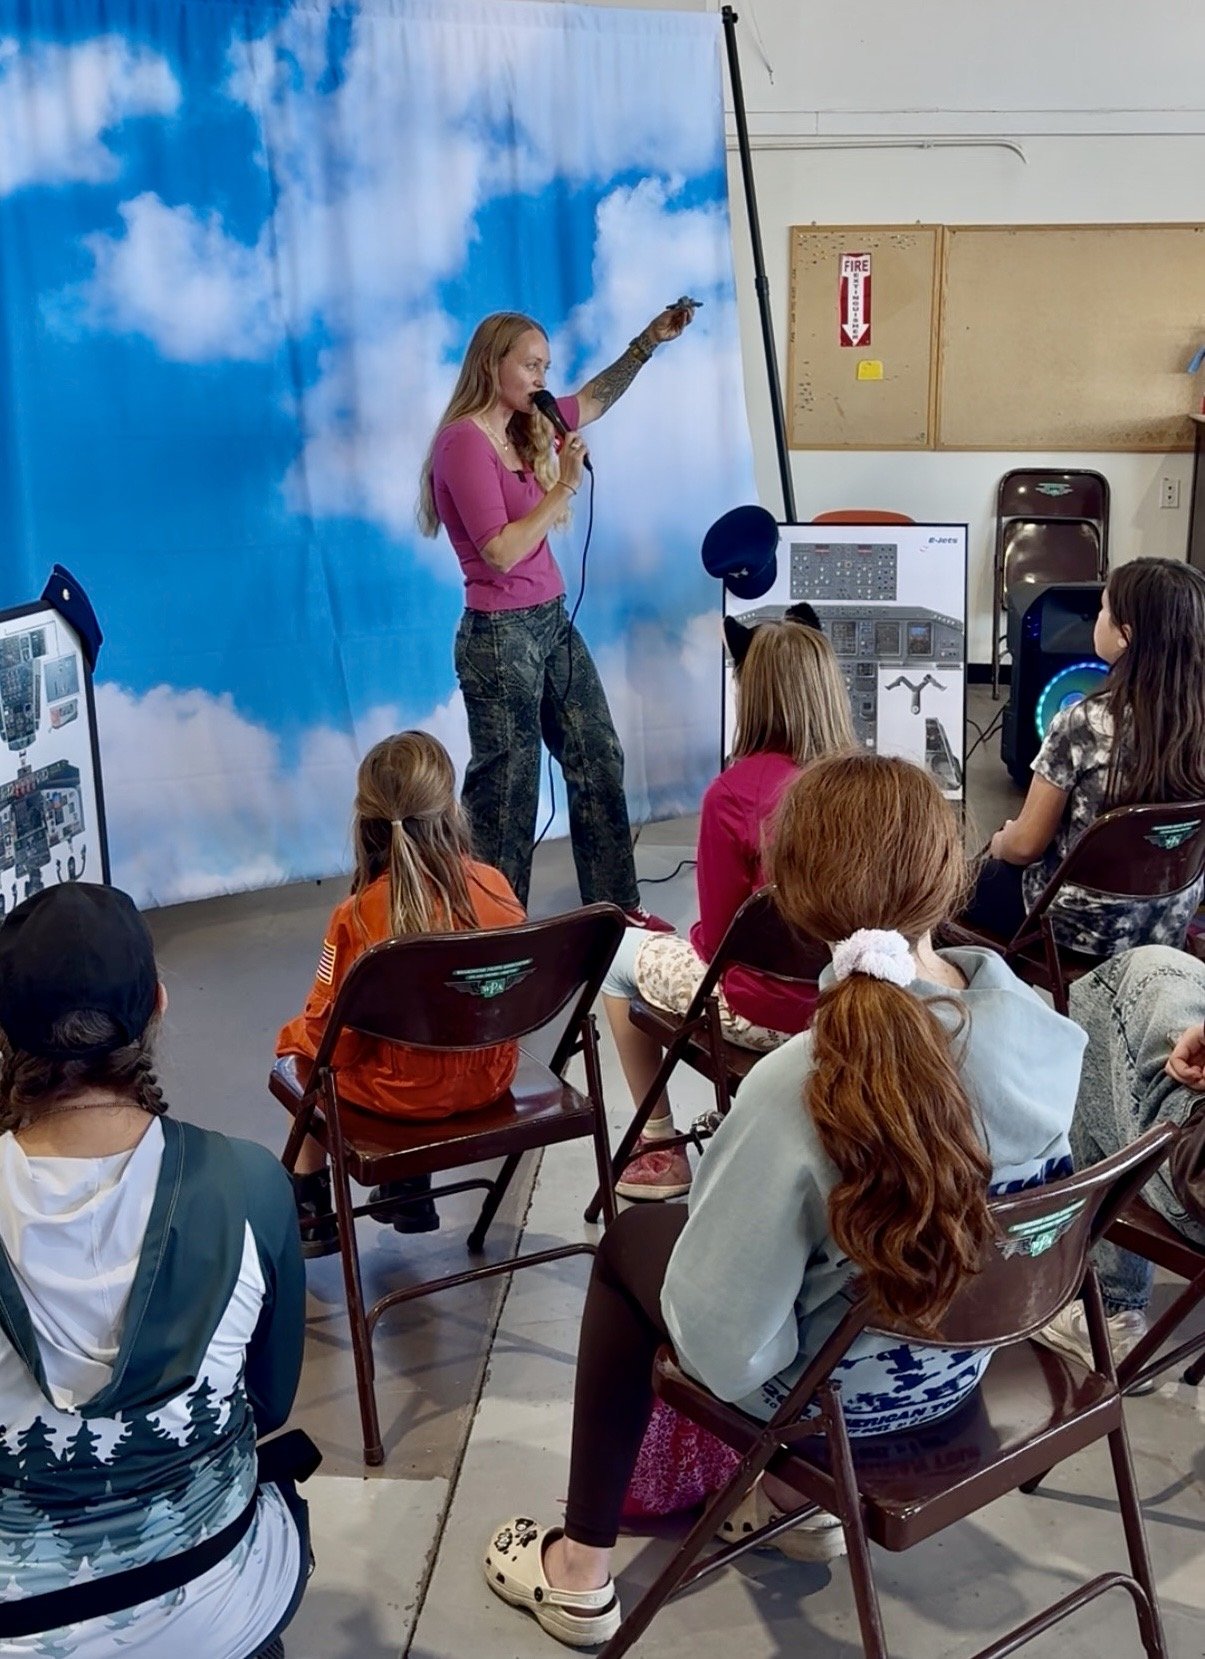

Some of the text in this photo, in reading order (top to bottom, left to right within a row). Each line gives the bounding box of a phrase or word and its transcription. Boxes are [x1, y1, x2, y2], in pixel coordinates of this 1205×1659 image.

[844, 260, 869, 272] FIRE
[852, 273, 860, 339] EXTINGUISHER
[846, 1407, 928, 1428] ERICAN
